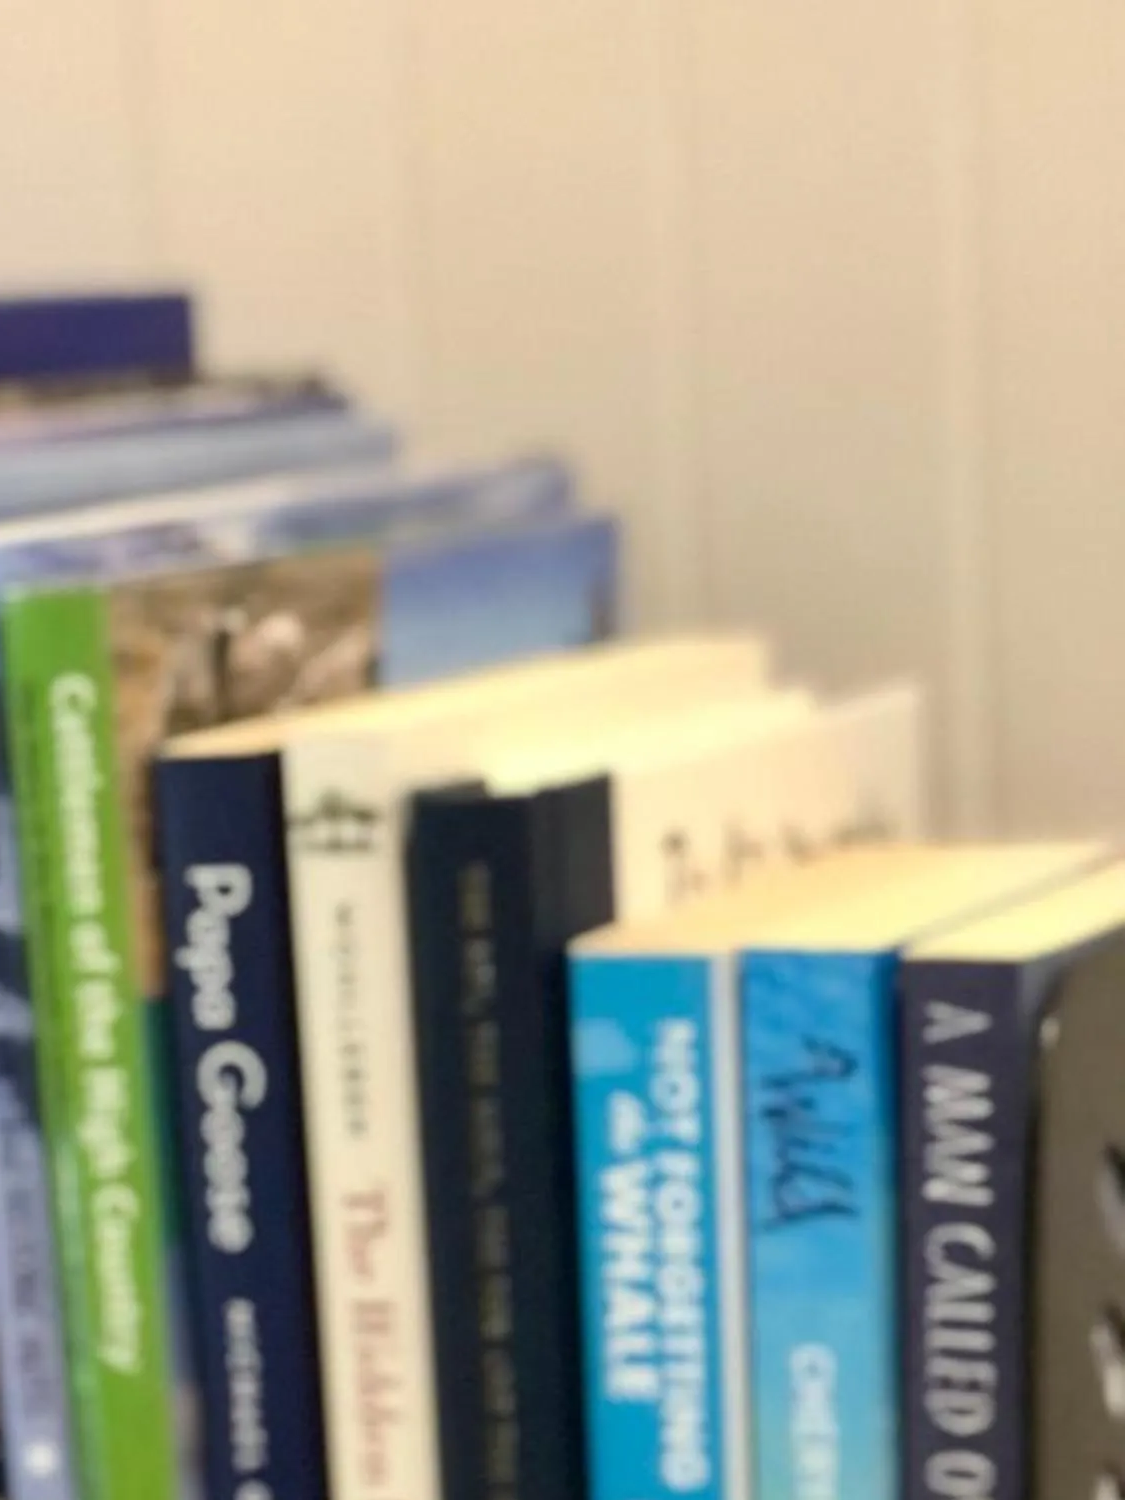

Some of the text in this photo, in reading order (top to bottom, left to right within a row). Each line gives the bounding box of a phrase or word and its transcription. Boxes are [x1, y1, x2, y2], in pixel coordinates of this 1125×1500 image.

[51, 673, 140, 1372] Cattlemen of the High Country
[176, 862, 267, 1253] Papa Goose
[922, 1000, 991, 1045] A
[343, 1187, 392, 1280] The
[923, 1064, 993, 1207] MAN
[604, 1092, 659, 1402] the WHALE
[649, 1019, 706, 1488] NOT FORGETTING
[924, 1222, 995, 1436] CALLED
[351, 1297, 399, 1487] Hidden
